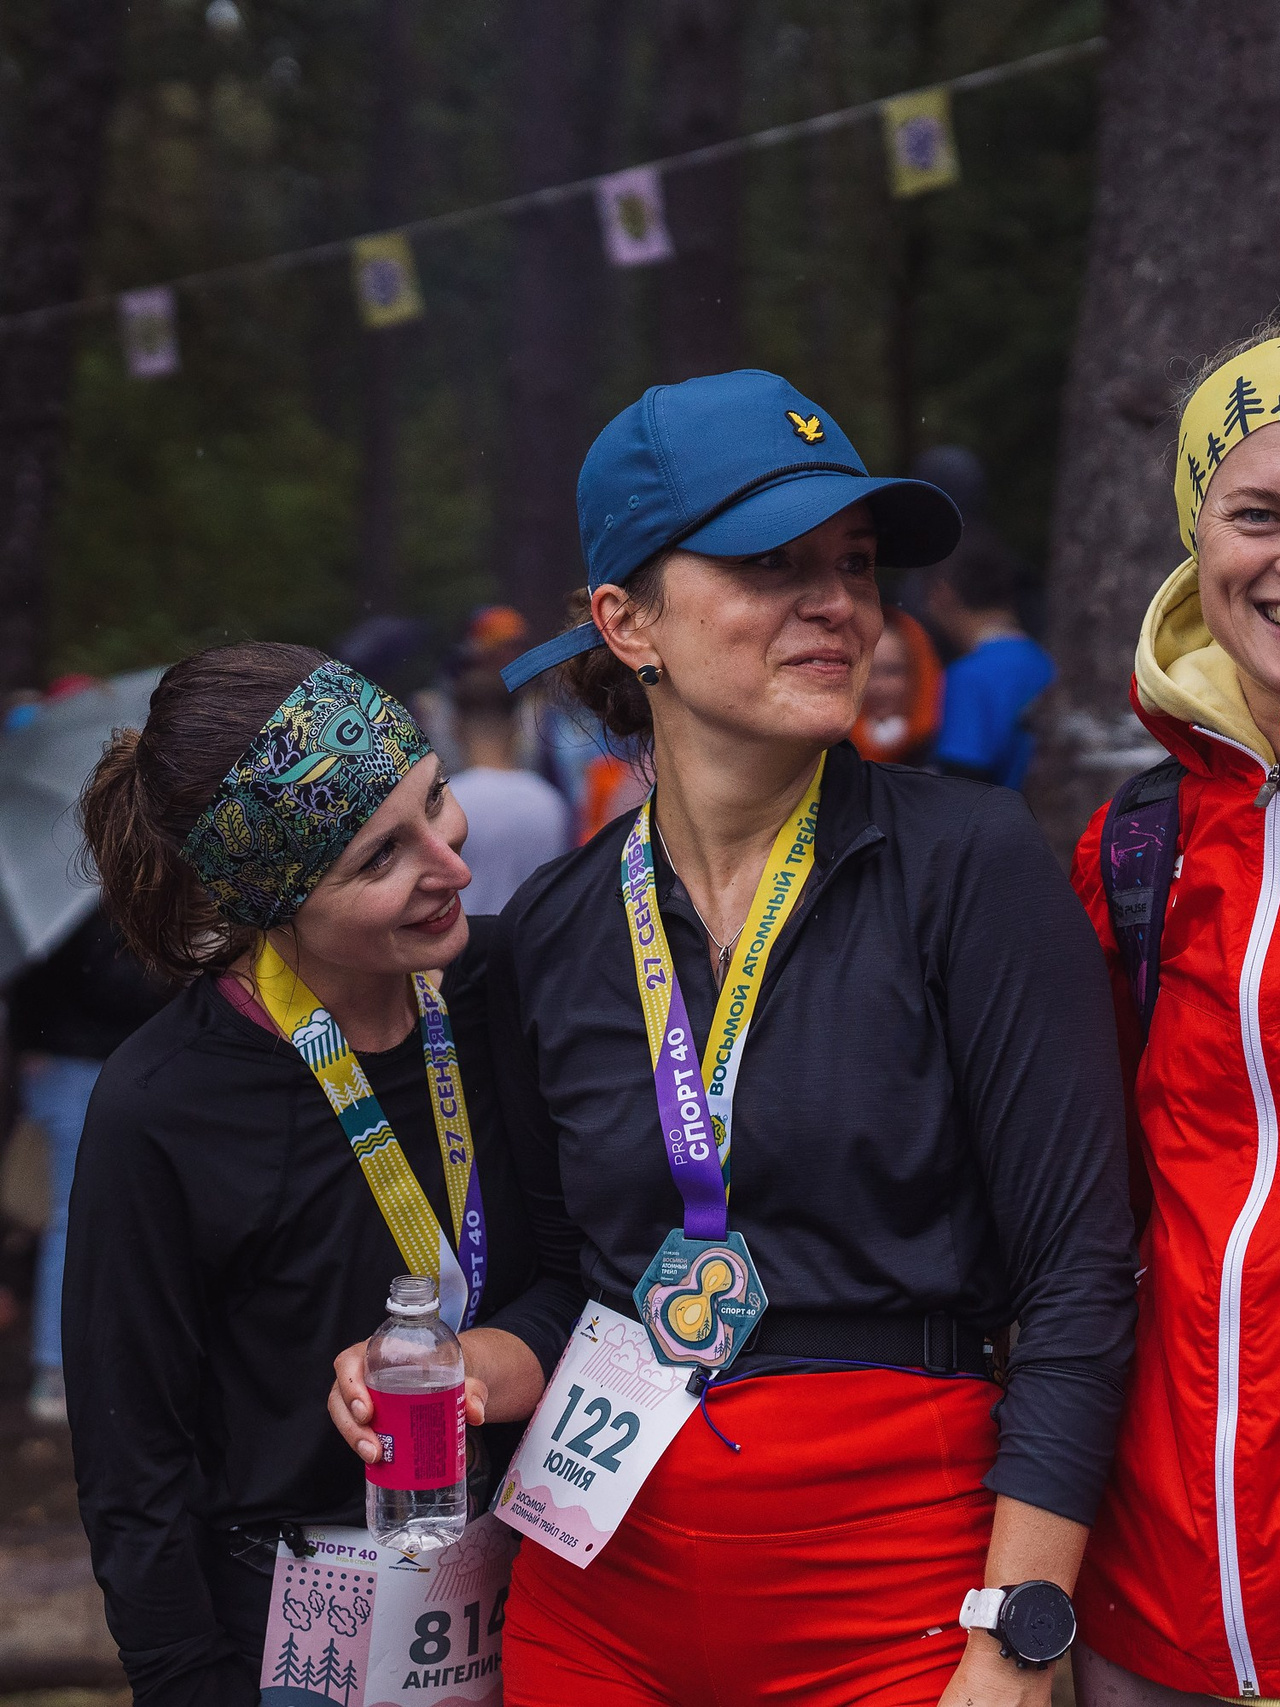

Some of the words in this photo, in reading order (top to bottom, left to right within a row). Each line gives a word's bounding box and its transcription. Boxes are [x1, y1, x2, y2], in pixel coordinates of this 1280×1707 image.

[308, 698, 348, 738] GAMASH
[335, 718, 365, 747] G
[643, 957, 667, 990] 27
[709, 984, 751, 1097] ВОСЬМОЙ
[742, 871, 796, 977] АТОМНЫЙ
[415, 974, 458, 1119] СЕНТЯБРЯ
[667, 1027, 688, 1062] 40
[673, 1069, 710, 1162] СПОРТ
[445, 1130, 467, 1165] 27
[669, 1129, 687, 1165] PRO
[466, 1210, 482, 1246] 40
[465, 1252, 484, 1329] ПОРТ
[720, 1307, 745, 1315] СПОРТ
[551, 1384, 640, 1474] 122
[542, 1449, 597, 1492] ЮЛИЯ
[515, 1491, 546, 1514] ВОСЬМОЙ
[510, 1502, 540, 1526] АТОМНЫЙ
[539, 1519, 560, 1537] ТРЕЙЛ
[559, 1531, 579, 1548] 2025
[358, 1549, 378, 1561] 40
